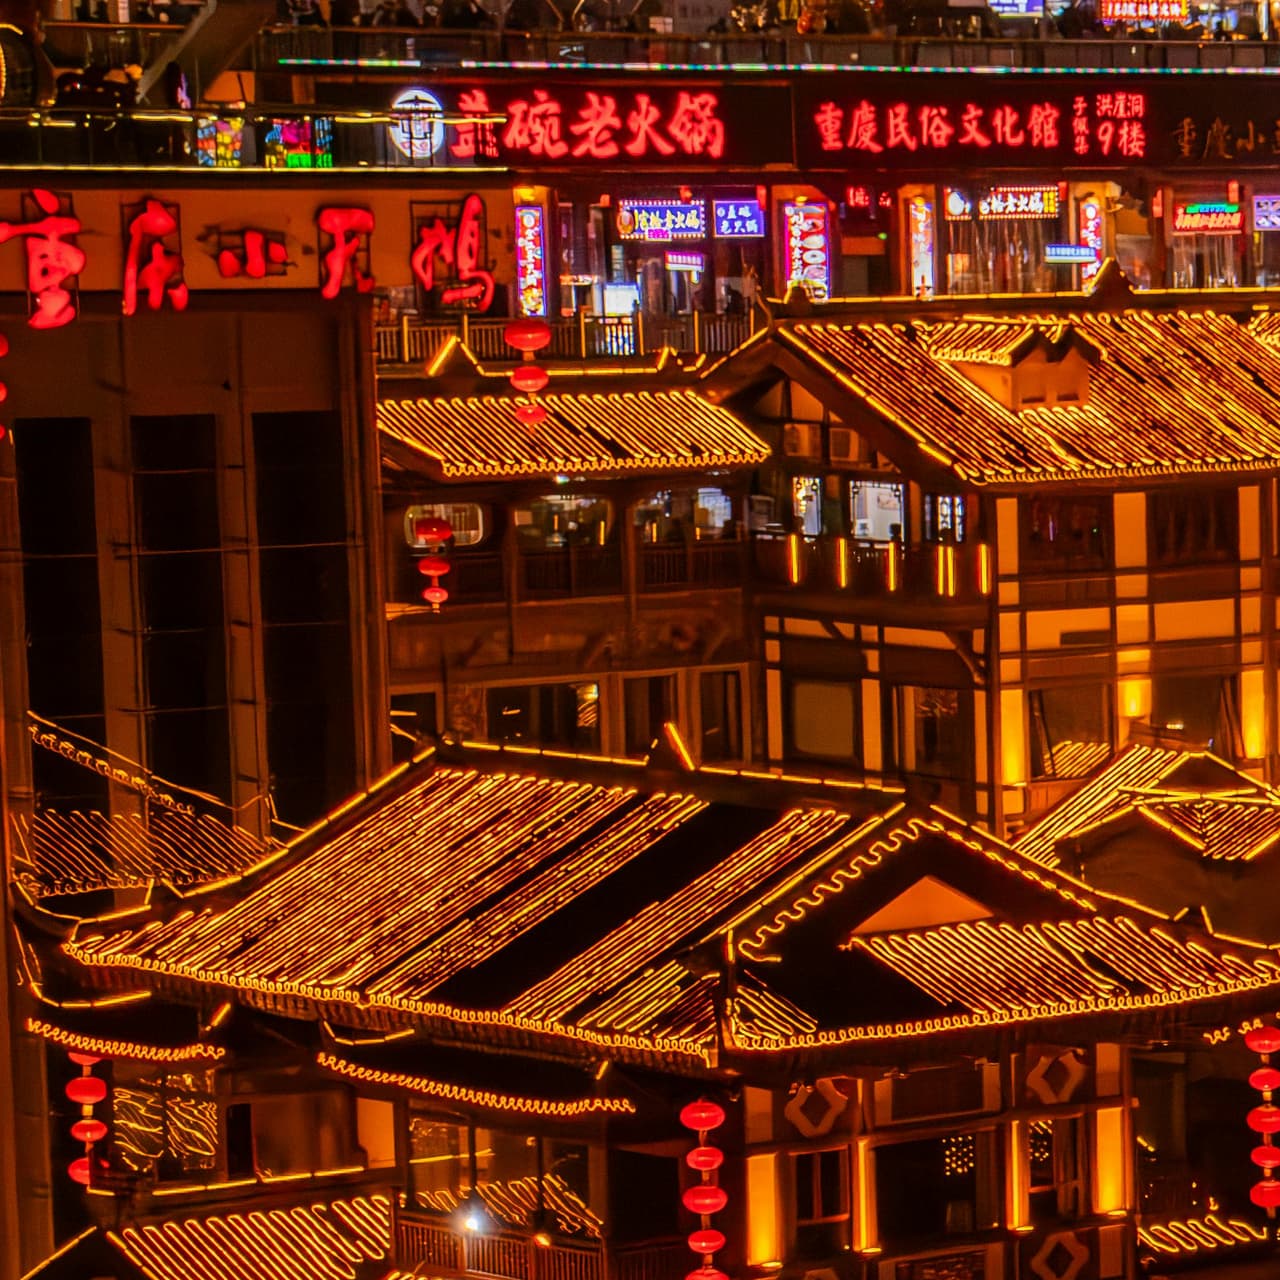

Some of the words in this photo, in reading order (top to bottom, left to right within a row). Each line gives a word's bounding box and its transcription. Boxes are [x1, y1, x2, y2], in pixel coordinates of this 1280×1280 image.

[1096, 92, 1146, 118] 洪崖洞
[814, 101, 1060, 153] 重慶民俗文化館
[1097, 120, 1146, 157] 9楼
